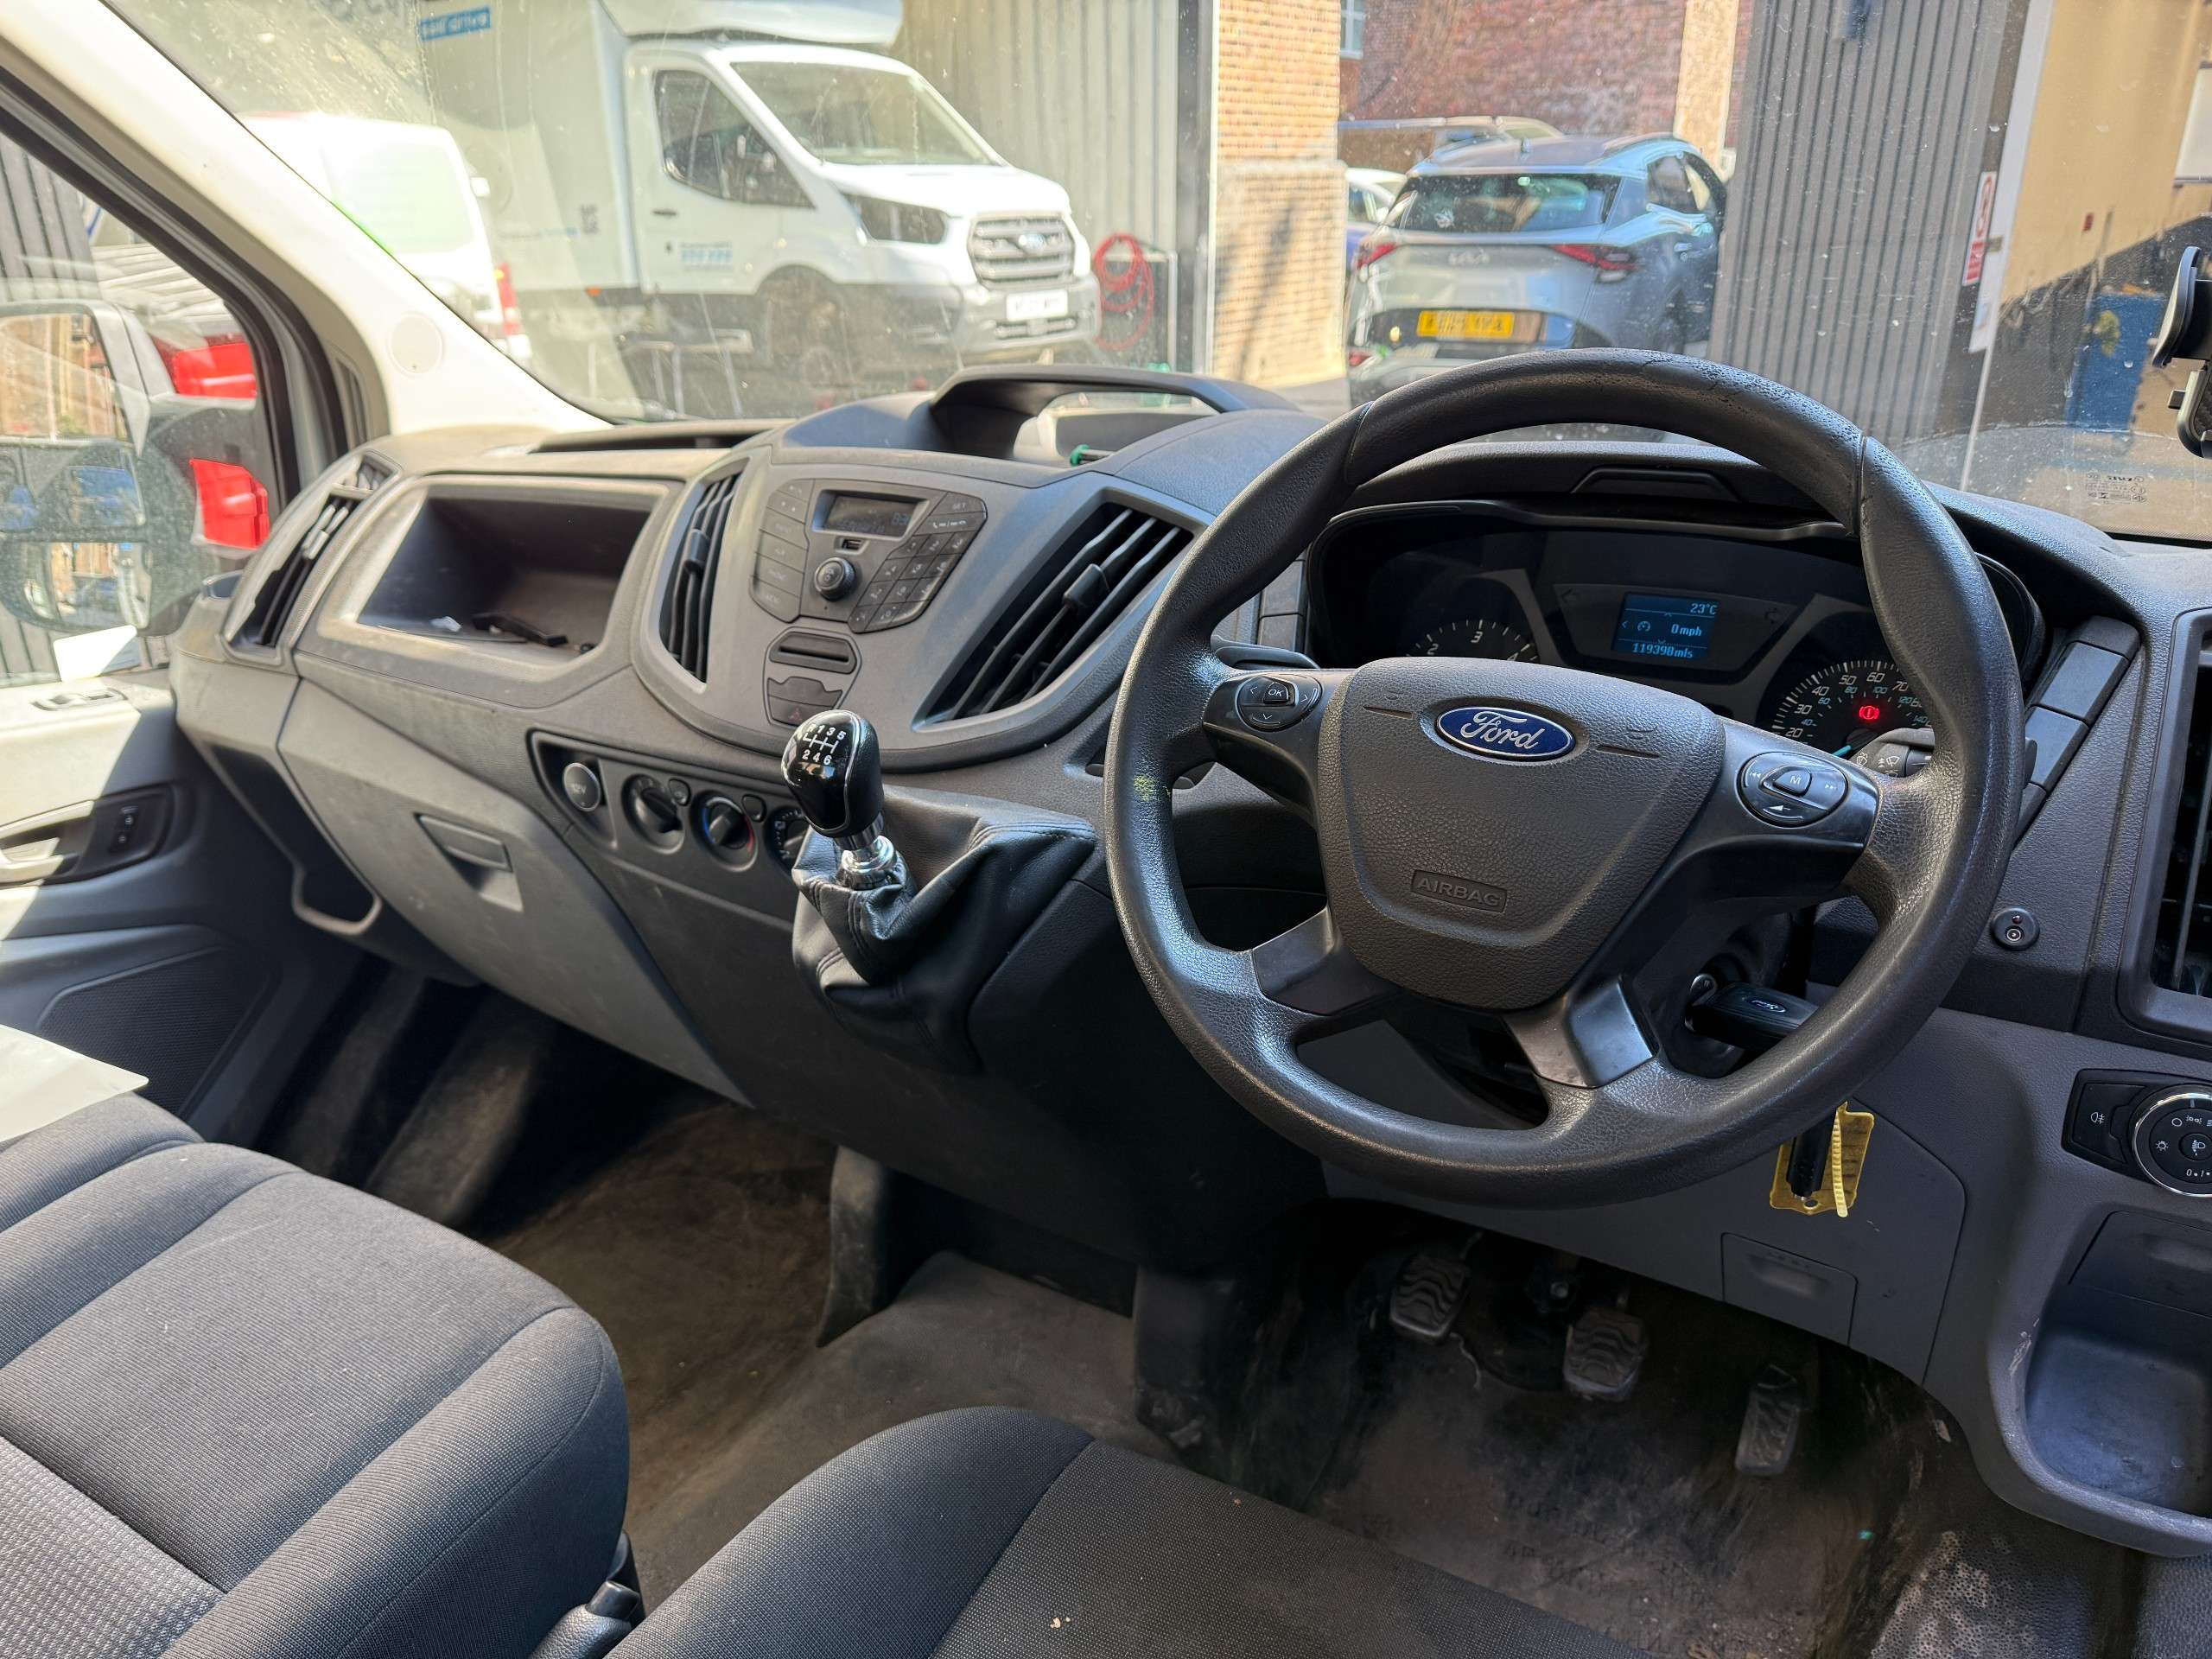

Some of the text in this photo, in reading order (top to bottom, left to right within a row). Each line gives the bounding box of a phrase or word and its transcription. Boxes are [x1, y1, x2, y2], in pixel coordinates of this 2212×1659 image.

[1690, 603, 1718, 615] 23°C
[1471, 631, 1483, 643] 3
[1427, 643, 1439, 655] 2
[1839, 675, 1858, 686] 50
[1866, 672, 1885, 683] 60
[1811, 686, 1829, 696] 40
[1892, 681, 1909, 691] 70
[1794, 704, 1812, 715] 30
[826, 728, 836, 736] 3
[836, 730, 847, 741] 5
[1460, 710, 1545, 750] Ford
[1786, 728, 1803, 738] 20
[802, 749, 832, 766] 2 4 6
[1417, 878, 1500, 906] AIRBAG
